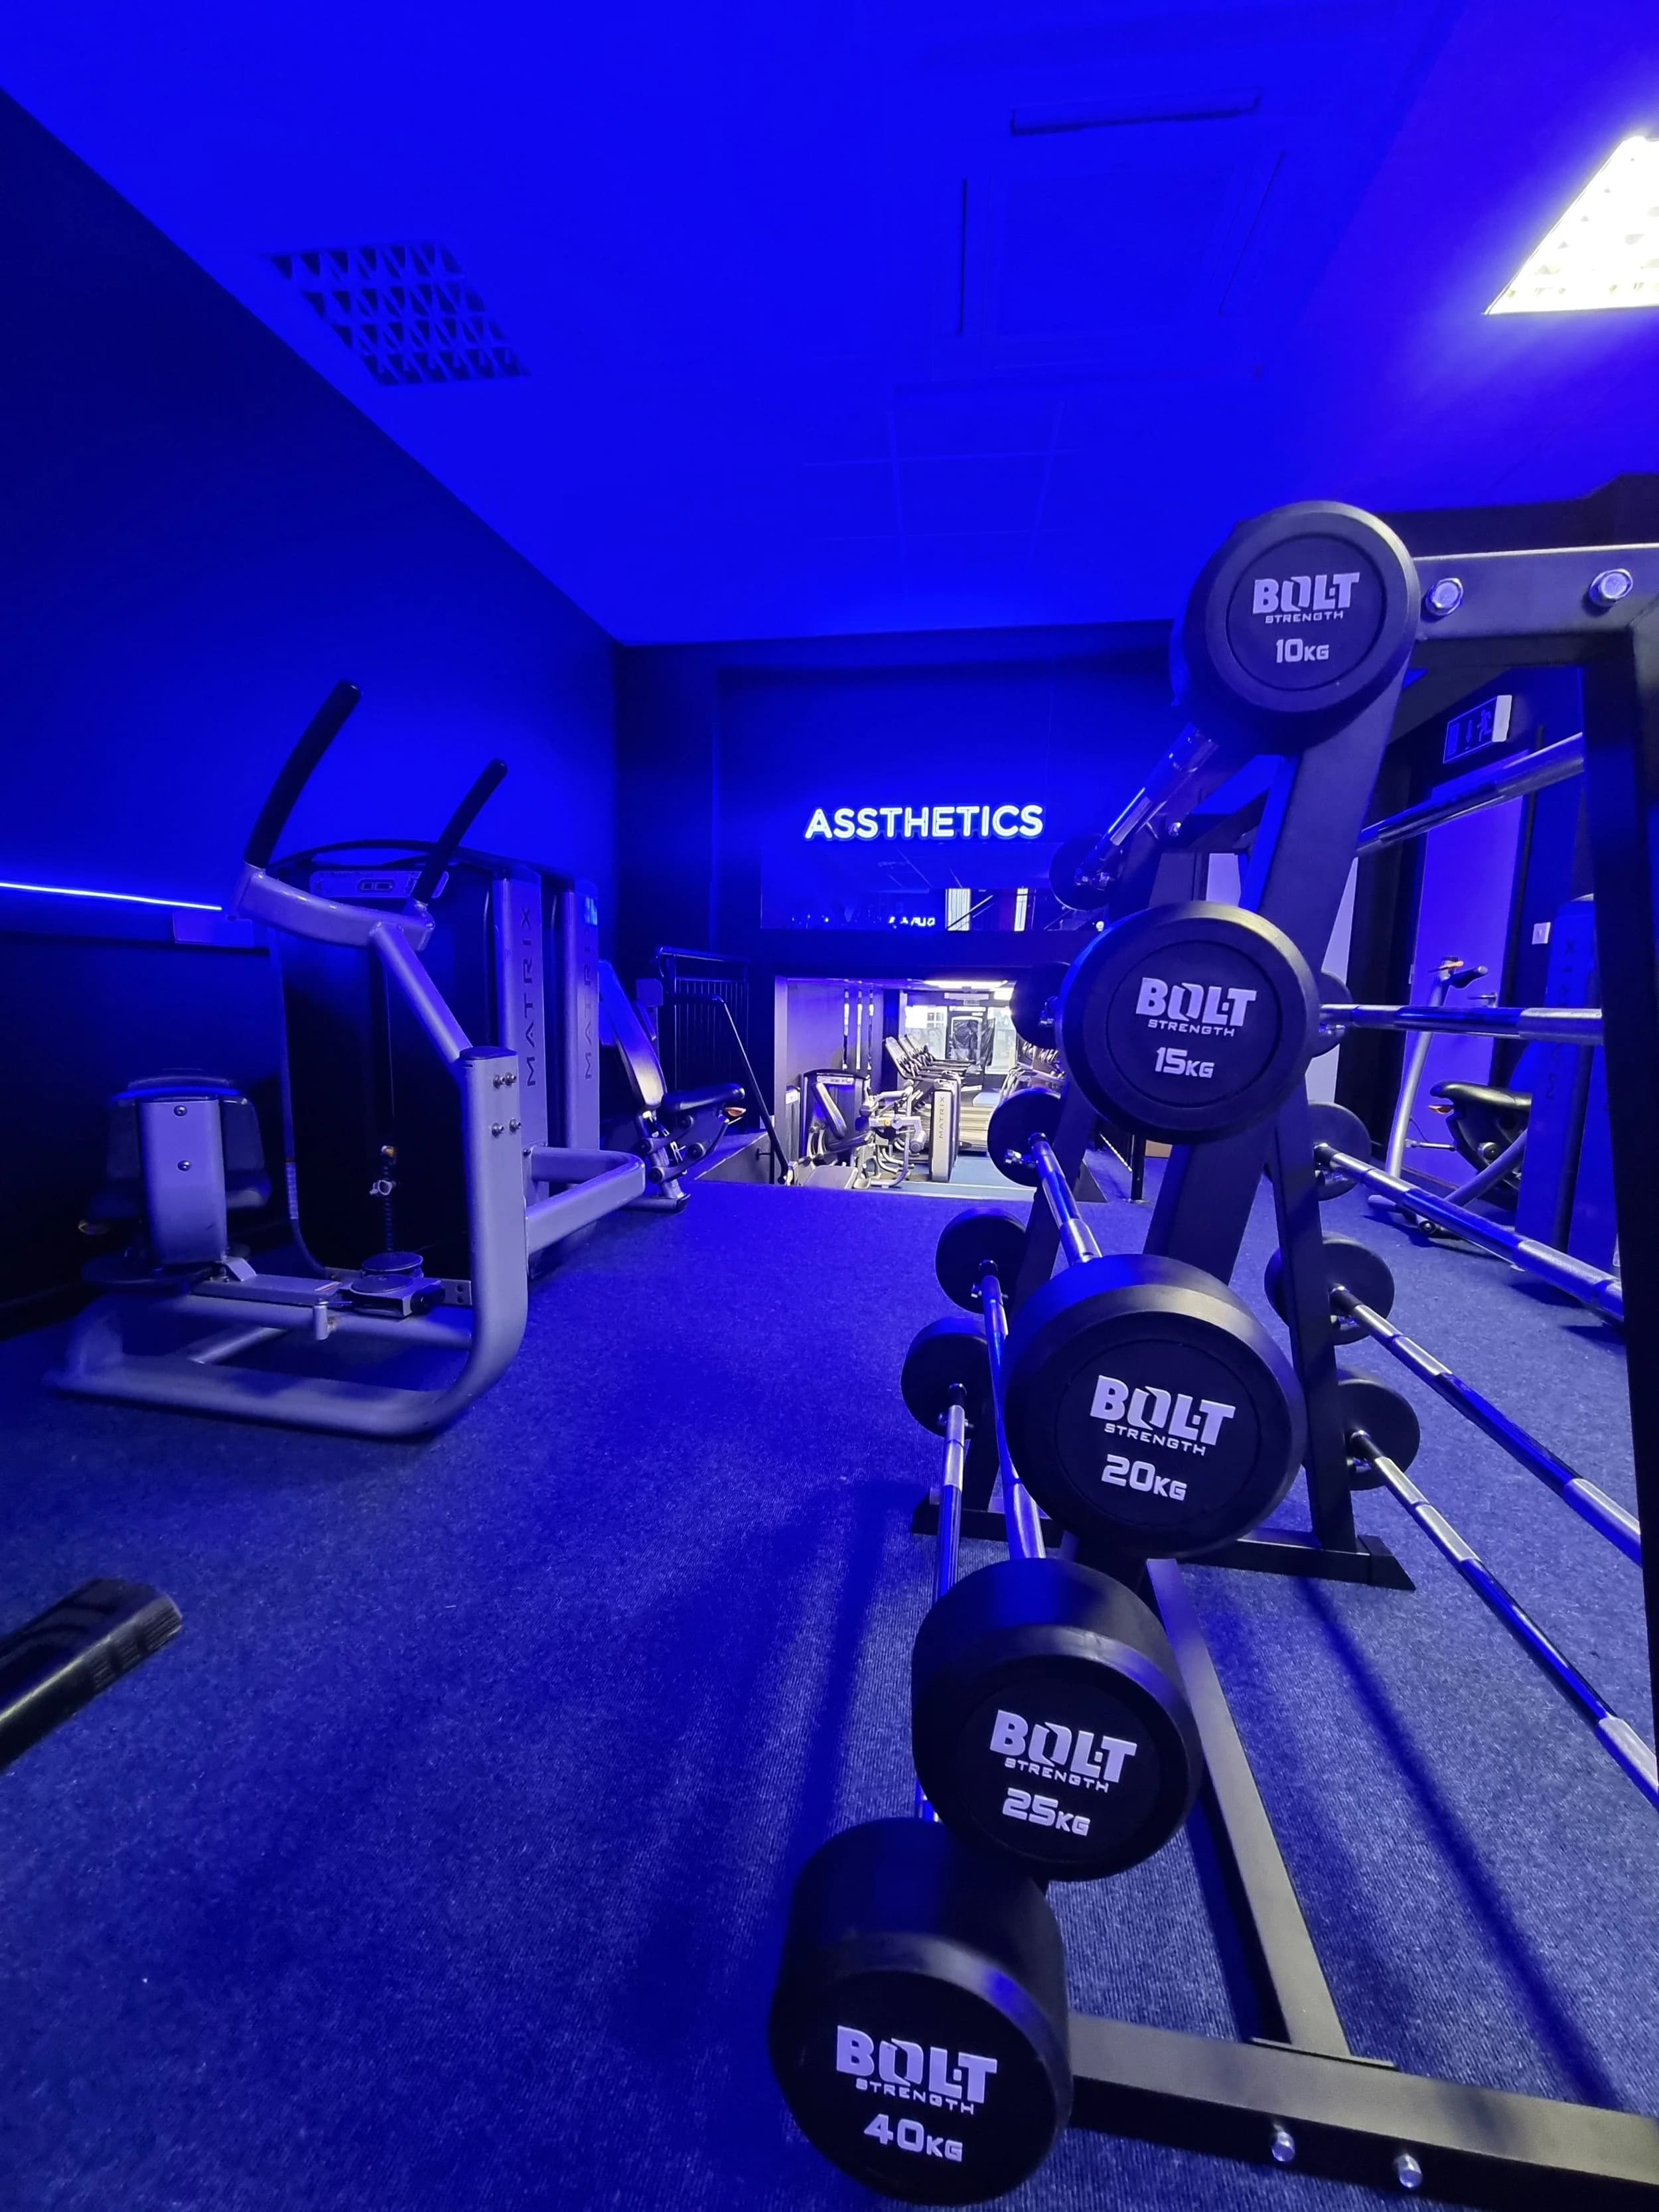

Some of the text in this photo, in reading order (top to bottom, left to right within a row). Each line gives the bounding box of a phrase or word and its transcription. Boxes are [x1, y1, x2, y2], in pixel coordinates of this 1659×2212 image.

[1252, 572, 1360, 614] BOLT
[1265, 611, 1343, 624] STRENGTH
[1276, 638, 1330, 663] 10KG
[804, 804, 1043, 840] ASSTHETICS
[521, 907, 536, 1087] MATRIX
[1135, 977, 1257, 1027] BOLT
[1148, 1019, 1235, 1037] STRENGTH
[1155, 1047, 1214, 1078] 15KG
[1090, 1374, 1236, 1445] BOLT
[1104, 1422, 1206, 1456] STRENGTH
[1101, 1453, 1187, 1501] 20KG
[989, 1710, 1137, 1783] BOLT
[1004, 1757, 1109, 1793] STRENGTH
[1002, 1787, 1091, 1836] 25KG
[836, 2025, 997, 2103] BOLT
[855, 2078, 974, 2115] STRENGTH
[864, 2113, 963, 2162] 40KG
